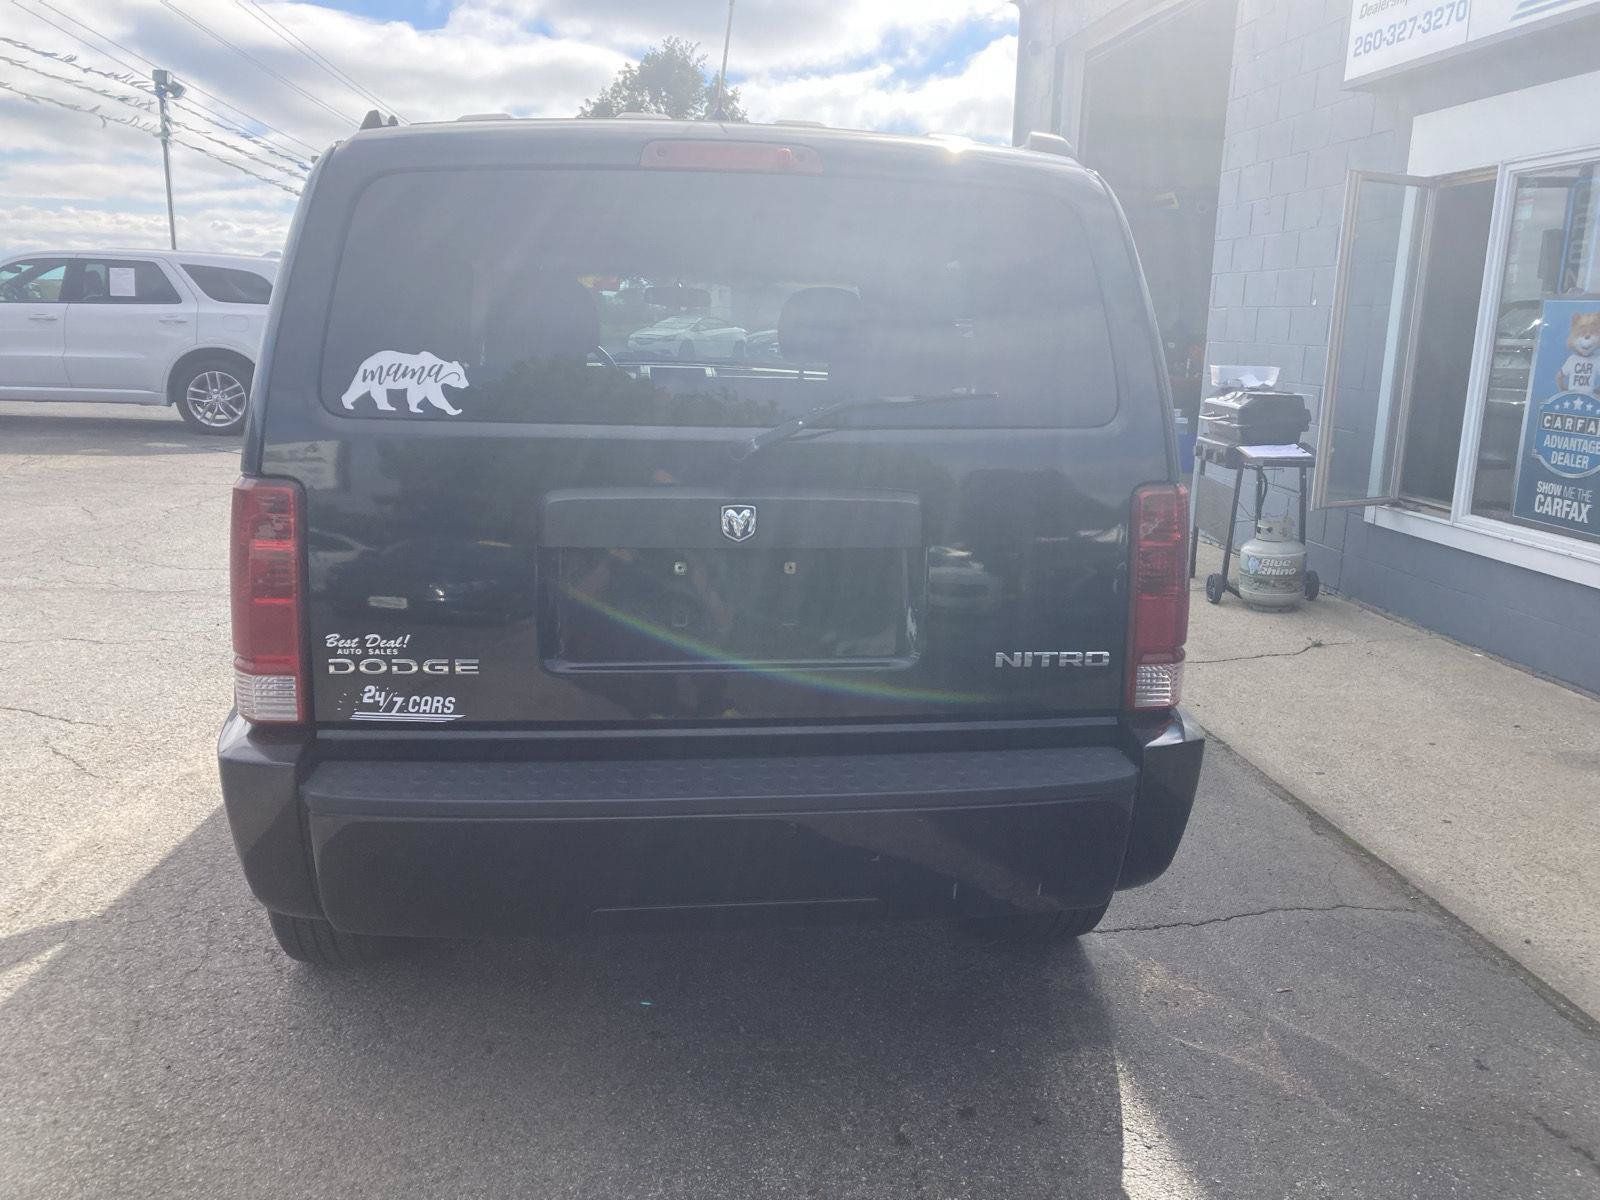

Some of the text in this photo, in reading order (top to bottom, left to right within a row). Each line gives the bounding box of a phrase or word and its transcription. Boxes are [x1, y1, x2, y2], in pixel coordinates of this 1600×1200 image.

[1359, 0, 1408, 19] Dealers
[362, 362, 459, 386] mama
[1574, 362, 1593, 375] CAR
[1572, 374, 1591, 387] FOX
[1550, 450, 1589, 469] DEALER
[1536, 480, 1562, 497] SHOW
[1577, 488, 1593, 503] THE
[1534, 493, 1592, 524] CARFAX
[1257, 566, 1297, 576] Rhino
[1260, 558, 1292, 567] Blue
[325, 633, 411, 648] Best Deal!
[327, 658, 480, 675] DODGE
[994, 651, 1110, 668] NITRO
[362, 685, 456, 714] 24/7 CARS
